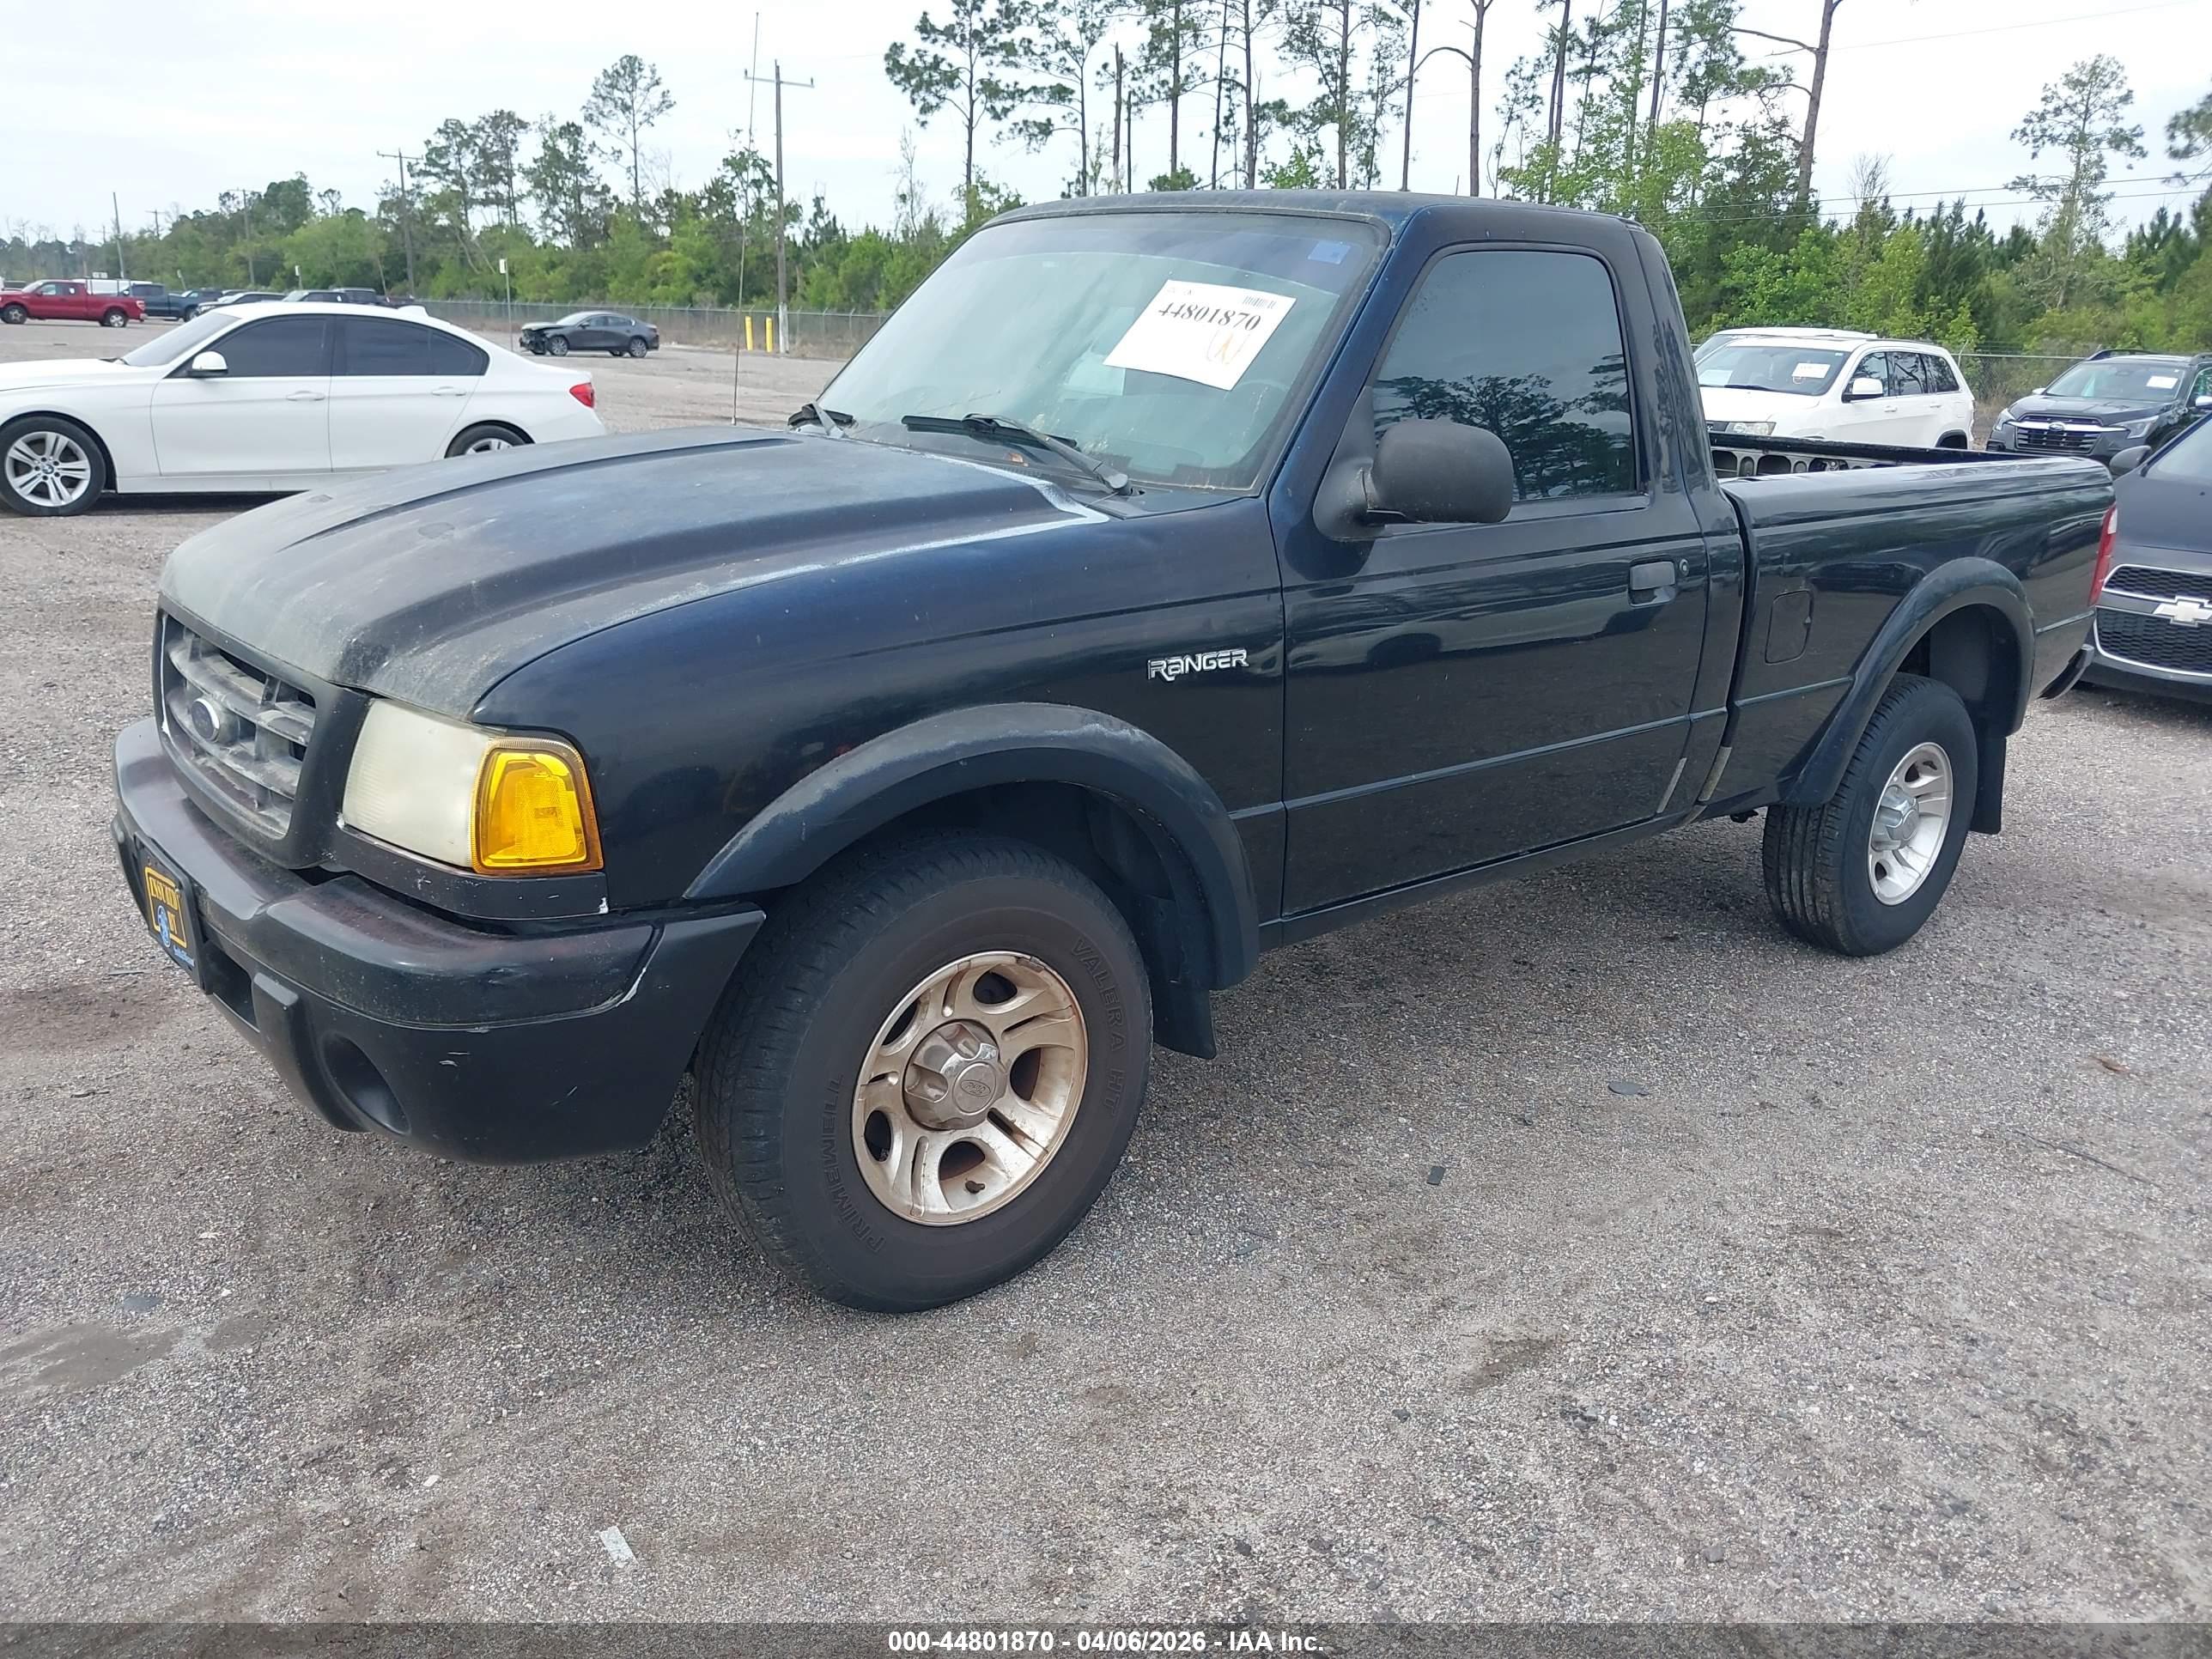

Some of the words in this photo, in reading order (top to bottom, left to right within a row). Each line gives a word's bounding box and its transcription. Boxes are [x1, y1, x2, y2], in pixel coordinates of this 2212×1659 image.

[1158, 302, 1261, 331] 44801870
[1147, 648, 1249, 682] RANGER
[1072, 937, 1126, 1052] VALERA
